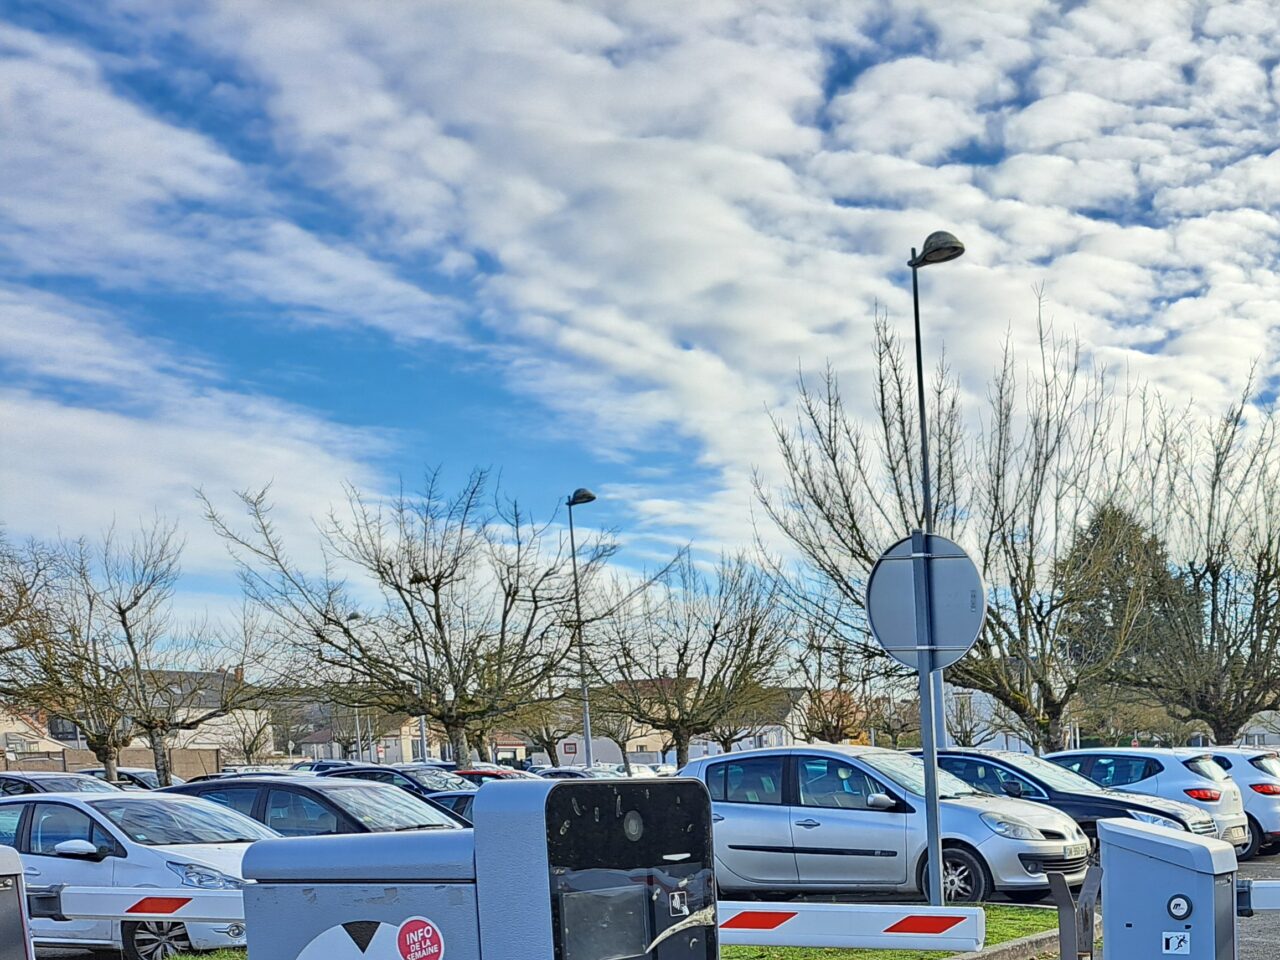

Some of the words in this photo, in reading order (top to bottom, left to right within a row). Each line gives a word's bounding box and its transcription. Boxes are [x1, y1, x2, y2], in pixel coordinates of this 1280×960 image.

[406, 926, 433, 945] INFO
[410, 942, 421, 953] DE
[421, 939, 431, 948] LA
